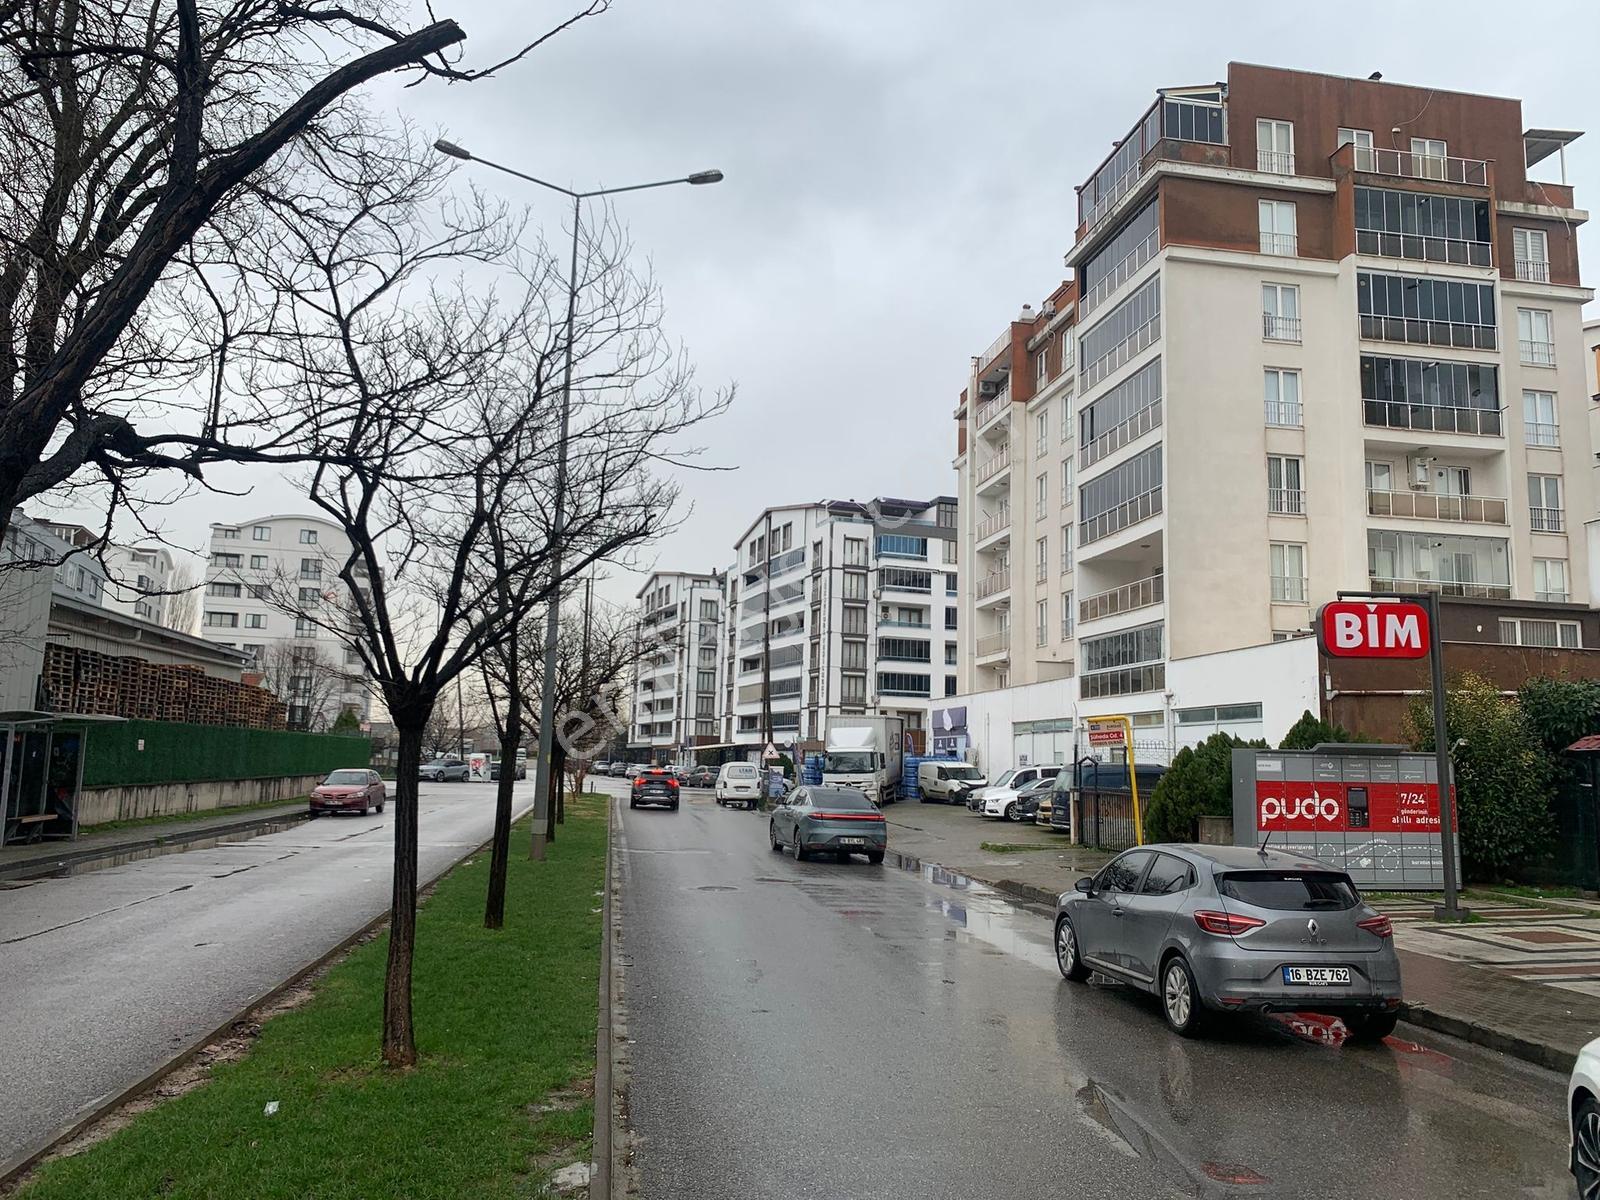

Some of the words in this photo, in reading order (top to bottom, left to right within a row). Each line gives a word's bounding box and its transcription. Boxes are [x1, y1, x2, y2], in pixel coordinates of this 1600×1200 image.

[1335, 604, 1422, 649] BİM
[1400, 792, 1426, 805] 7/24
[1261, 790, 1339, 827] pudo
[1415, 815, 1441, 824] adresi
[1290, 968, 1302, 981] 16
[1306, 968, 1328, 981] BZE
[1328, 969, 1349, 981] 762
